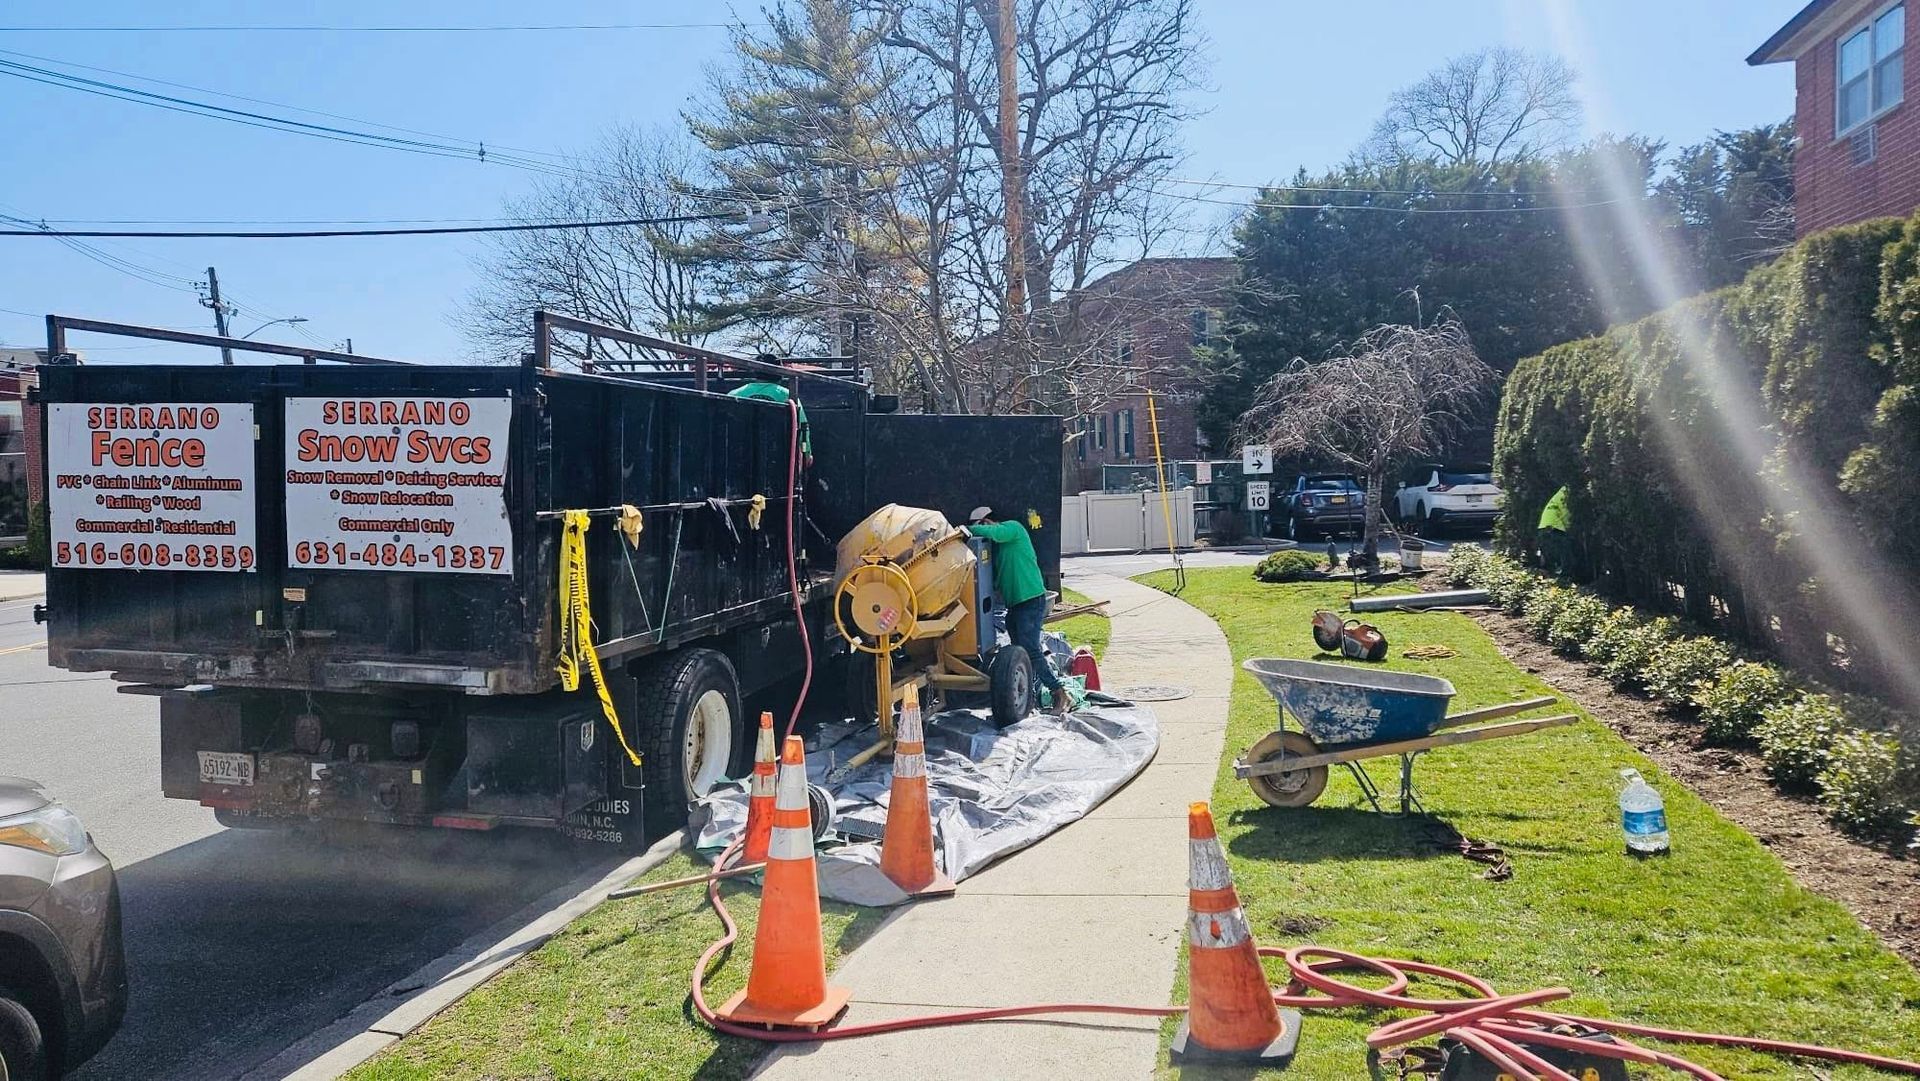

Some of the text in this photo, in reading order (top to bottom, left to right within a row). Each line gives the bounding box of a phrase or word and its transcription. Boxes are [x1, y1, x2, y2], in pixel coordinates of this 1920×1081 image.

[88, 407, 219, 429] SERRANO
[323, 401, 470, 425] SERRANO
[92, 431, 205, 467] Fence
[298, 429, 491, 464] Snow Svcs
[1252, 449, 1263, 457] IN
[57, 475, 242, 491] PVC Chain Link Aluminum
[287, 470, 324, 483] Snow
[326, 471, 383, 485] Removal
[396, 472, 447, 488] Deicing
[106, 495, 201, 512] Railing Wood
[342, 491, 454, 506] Snow Relocation
[1252, 497, 1266, 507] 10
[76, 519, 236, 535] Commercial Residential
[339, 518, 454, 537] Commercial Only
[57, 542, 254, 568] 516-608-8359
[296, 542, 504, 569] 631-484-1337
